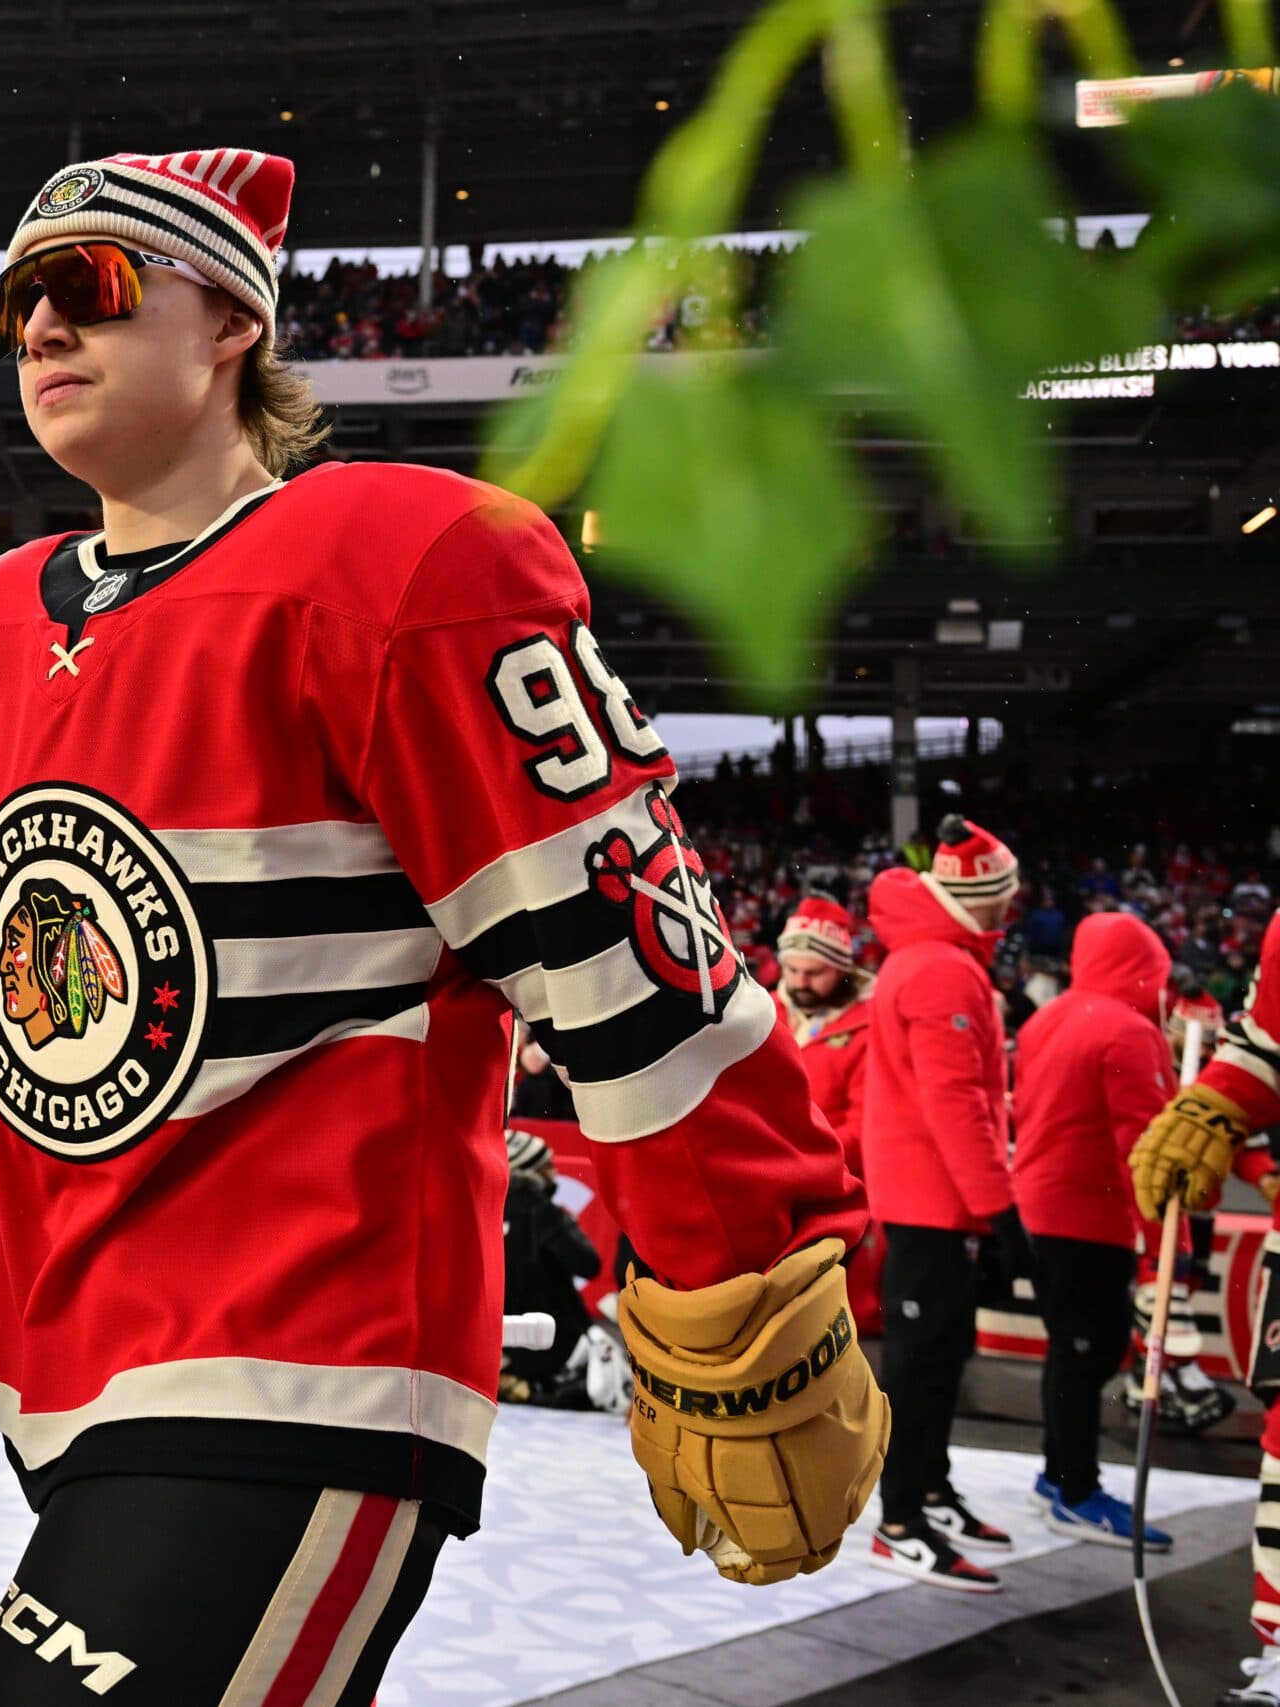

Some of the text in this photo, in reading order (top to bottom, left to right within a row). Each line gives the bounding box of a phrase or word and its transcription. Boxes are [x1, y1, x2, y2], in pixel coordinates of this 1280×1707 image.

[1169, 343, 1217, 370] AND
[1217, 341, 1280, 368] YOUR
[628, 1305, 852, 1419] HERWOOD
